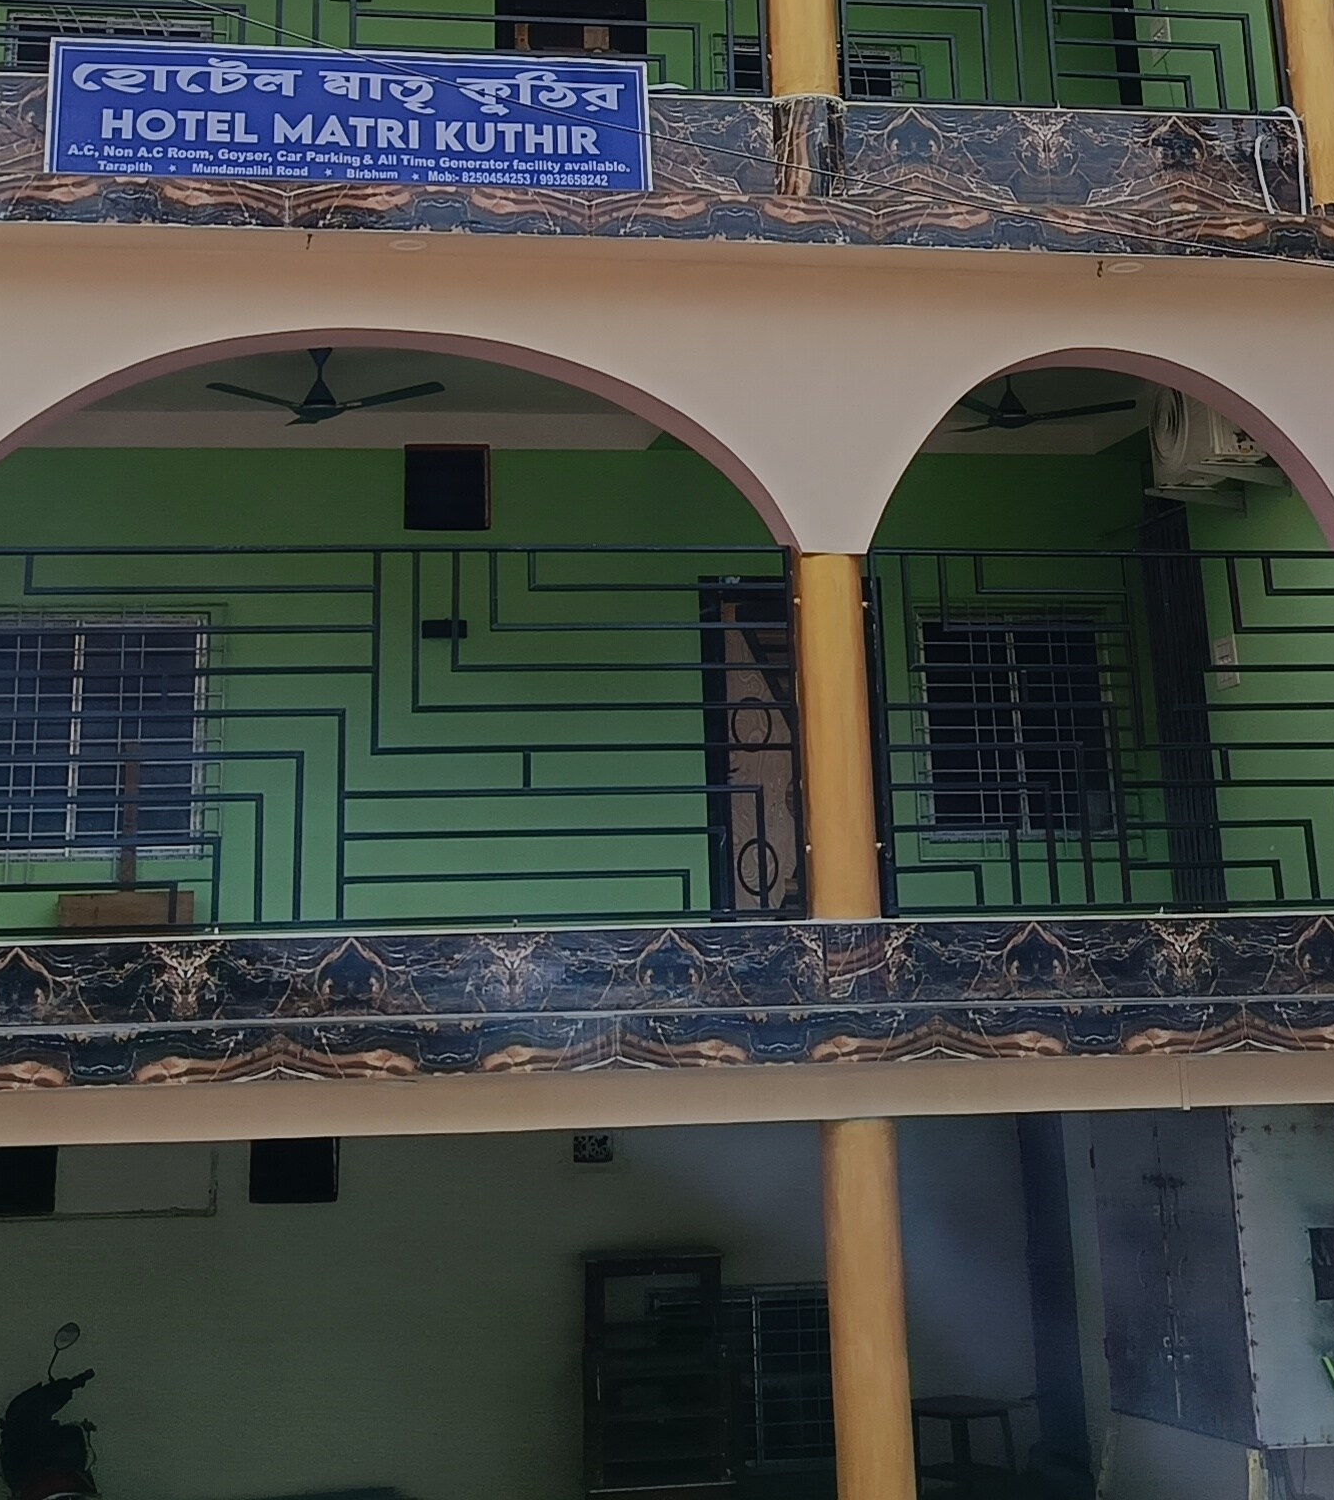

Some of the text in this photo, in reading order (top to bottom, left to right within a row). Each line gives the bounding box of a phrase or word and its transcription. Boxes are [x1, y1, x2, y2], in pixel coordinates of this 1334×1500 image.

[72, 57, 625, 116] হোটেল মাতৃ কুঠির
[101, 107, 601, 155] HOTEL MATRI KUTHIR
[67, 144, 631, 173] A.C, Non A.C Room, Geyser, Car Parking & All Time Generator facility available.
[98, 160, 153, 174] Tarapith
[192, 163, 273, 175] Mundamalini
[276, 166, 309, 176] Road
[346, 168, 398, 180] Birbhum
[461, 172, 531, 185] 8250454253
[539, 174, 609, 187] 9932658242
